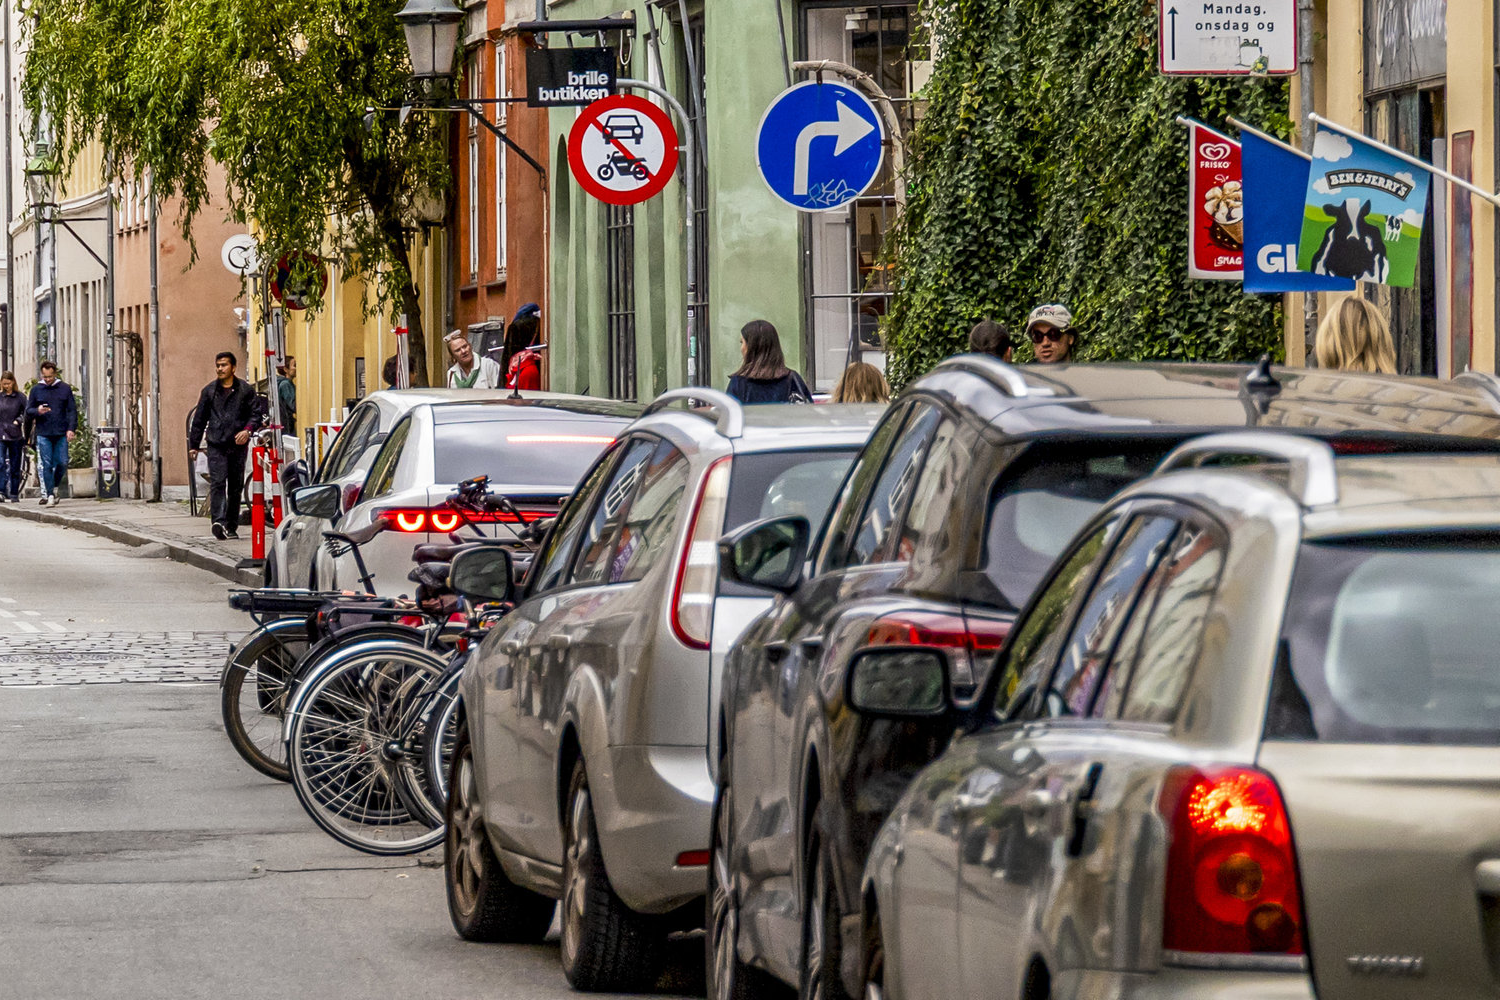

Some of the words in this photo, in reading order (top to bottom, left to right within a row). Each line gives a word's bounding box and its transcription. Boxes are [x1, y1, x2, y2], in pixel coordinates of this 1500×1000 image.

[1195, 20, 1249, 32] onsdag
[1257, 21, 1274, 32] og
[568, 70, 608, 85] brille
[539, 86, 609, 101] butikken
[1200, 161, 1229, 169] FRISKO
[1217, 256, 1242, 266] SMAG
